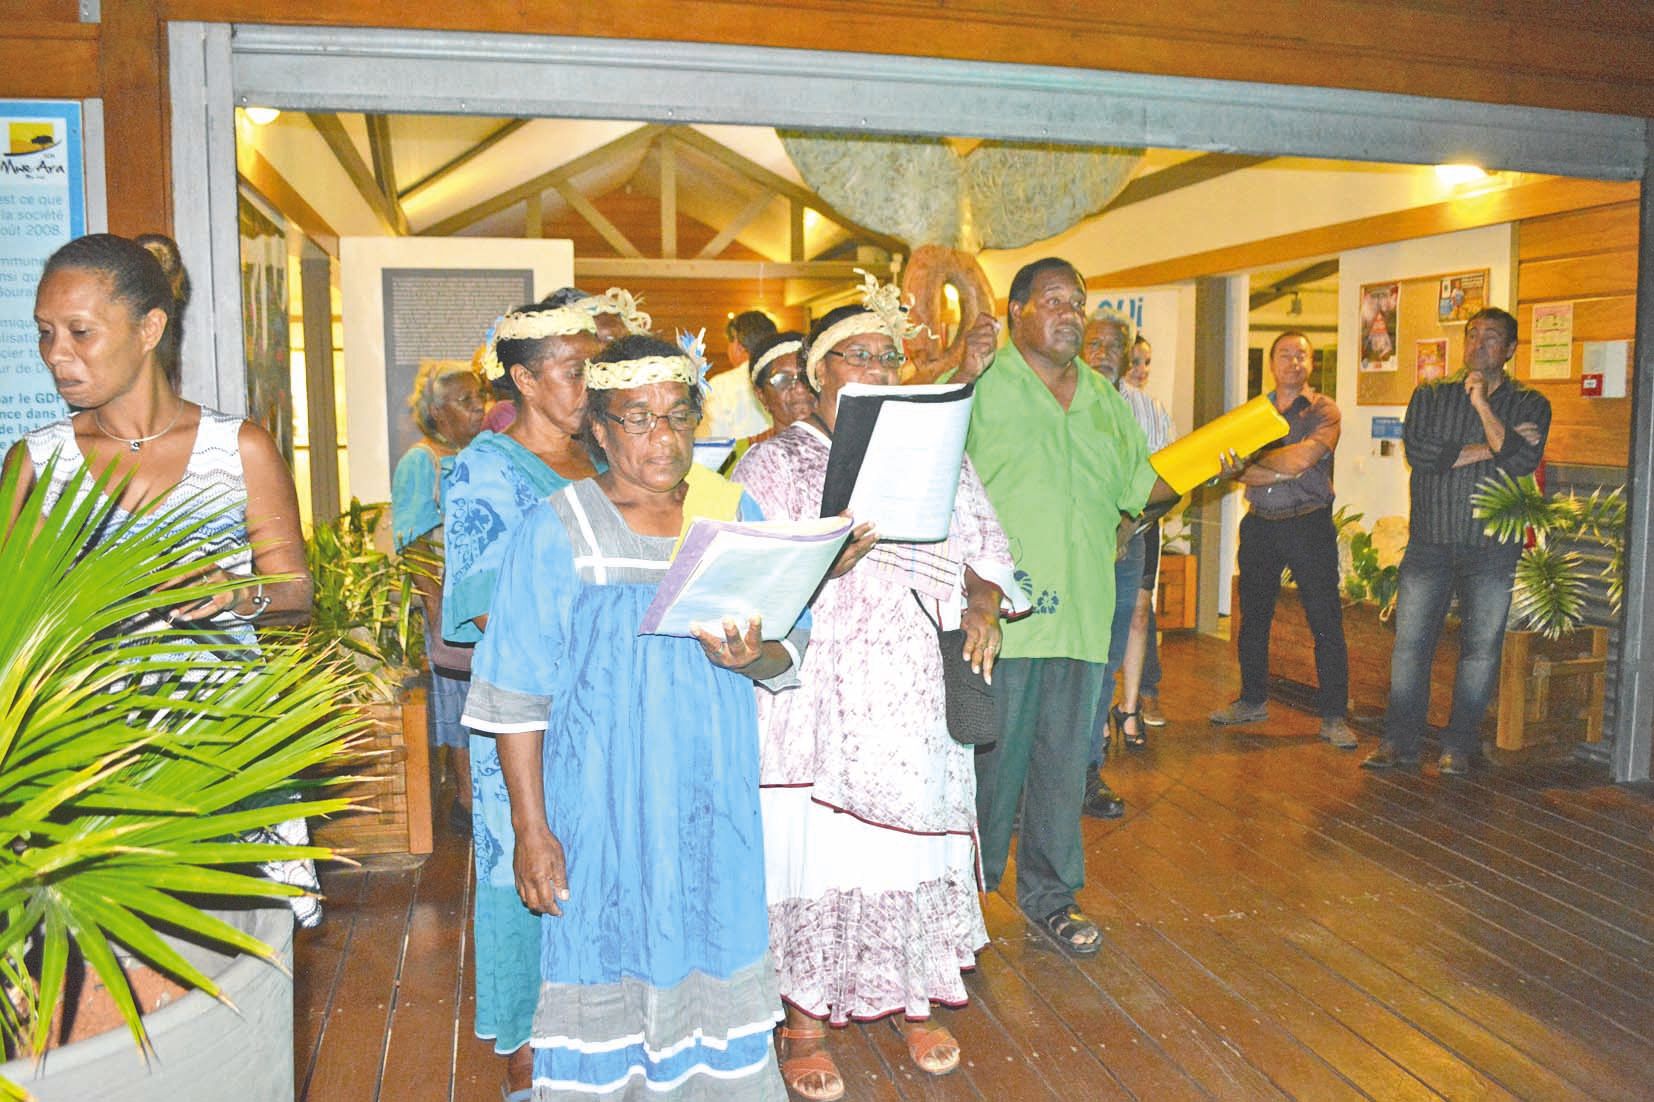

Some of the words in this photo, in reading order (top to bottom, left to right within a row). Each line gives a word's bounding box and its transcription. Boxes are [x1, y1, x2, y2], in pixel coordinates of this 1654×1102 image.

[18, 209, 64, 221] société
[19, 392, 31, 404] le
[26, 407, 57, 419] dans
